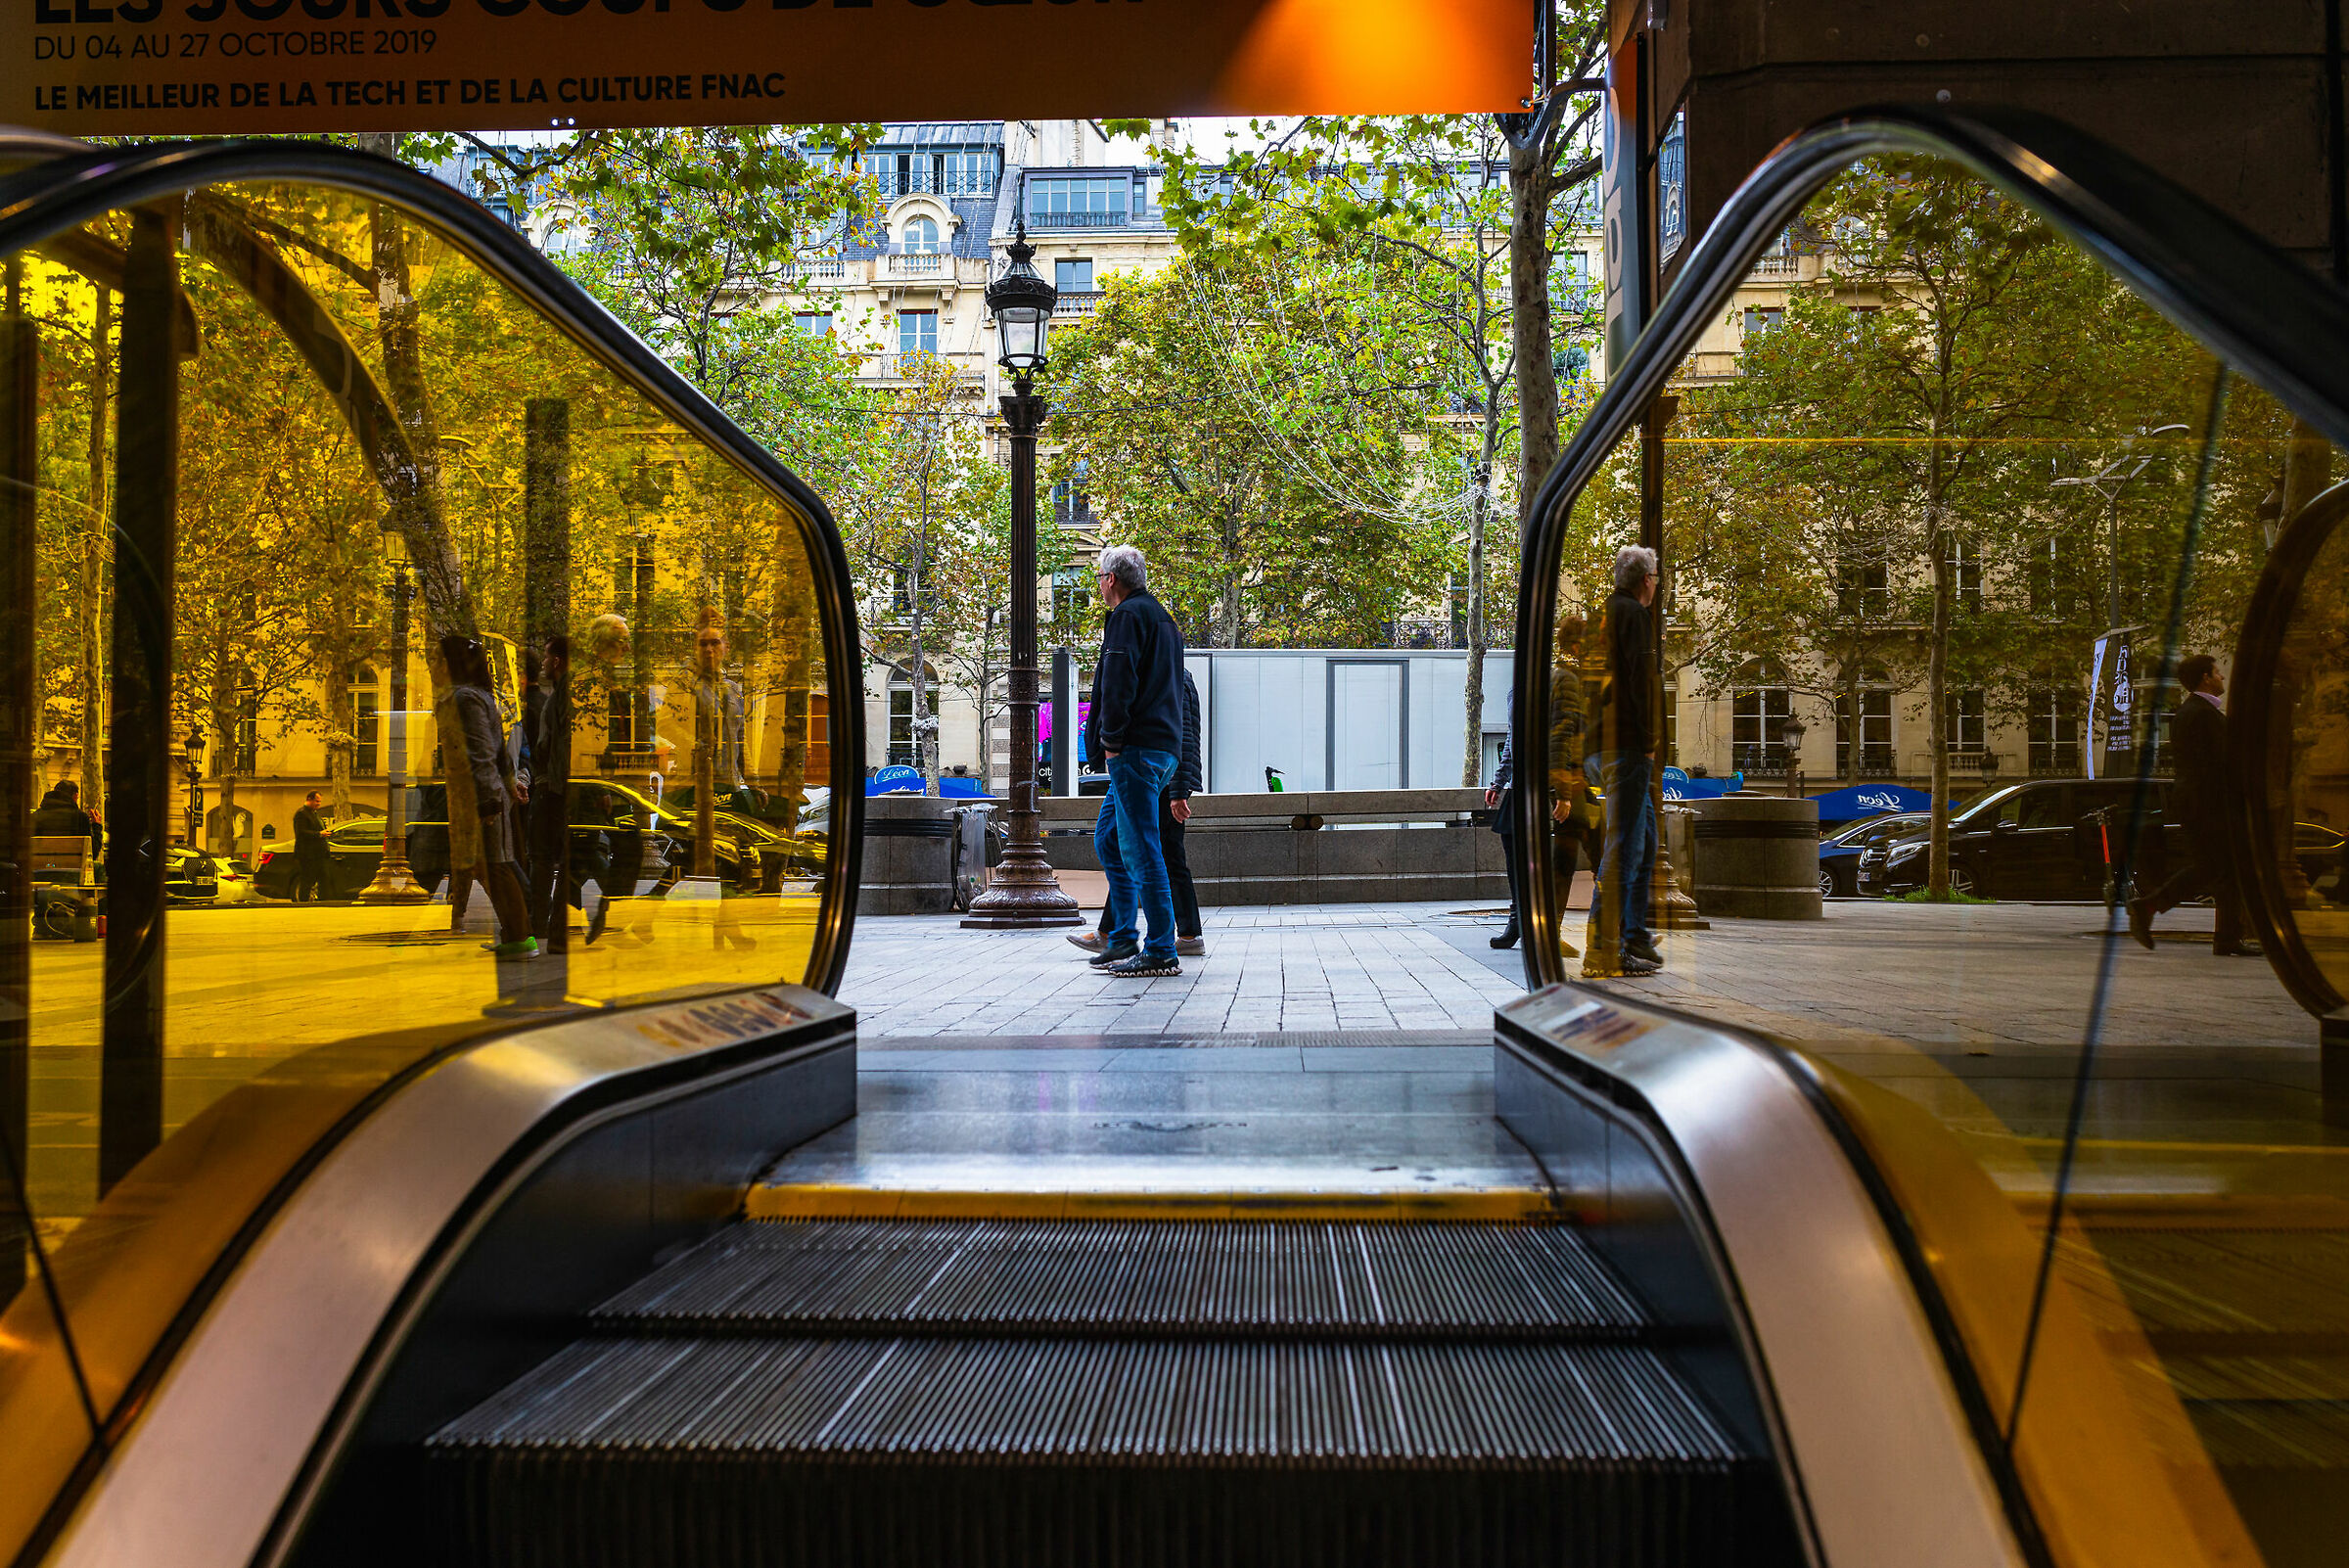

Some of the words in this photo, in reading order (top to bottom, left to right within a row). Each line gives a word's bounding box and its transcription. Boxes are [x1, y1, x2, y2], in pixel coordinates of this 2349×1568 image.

[33, 35, 76, 60] DU
[84, 34, 124, 60] 04
[129, 33, 170, 59] AU
[179, 33, 210, 58] 27
[218, 29, 366, 57] OCTOBRE
[373, 28, 438, 55] 2019
[34, 85, 69, 112] LE
[75, 83, 221, 111] MEILLEUR
[229, 81, 271, 109] DE
[278, 80, 319, 108] LA
[324, 79, 406, 107] TECH
[415, 78, 452, 106] ET
[459, 78, 502, 105] DE
[509, 78, 549, 105] LA
[556, 74, 693, 103] CULTURE
[701, 71, 787, 101] FNAC
[1602, 86, 1624, 386] nac
